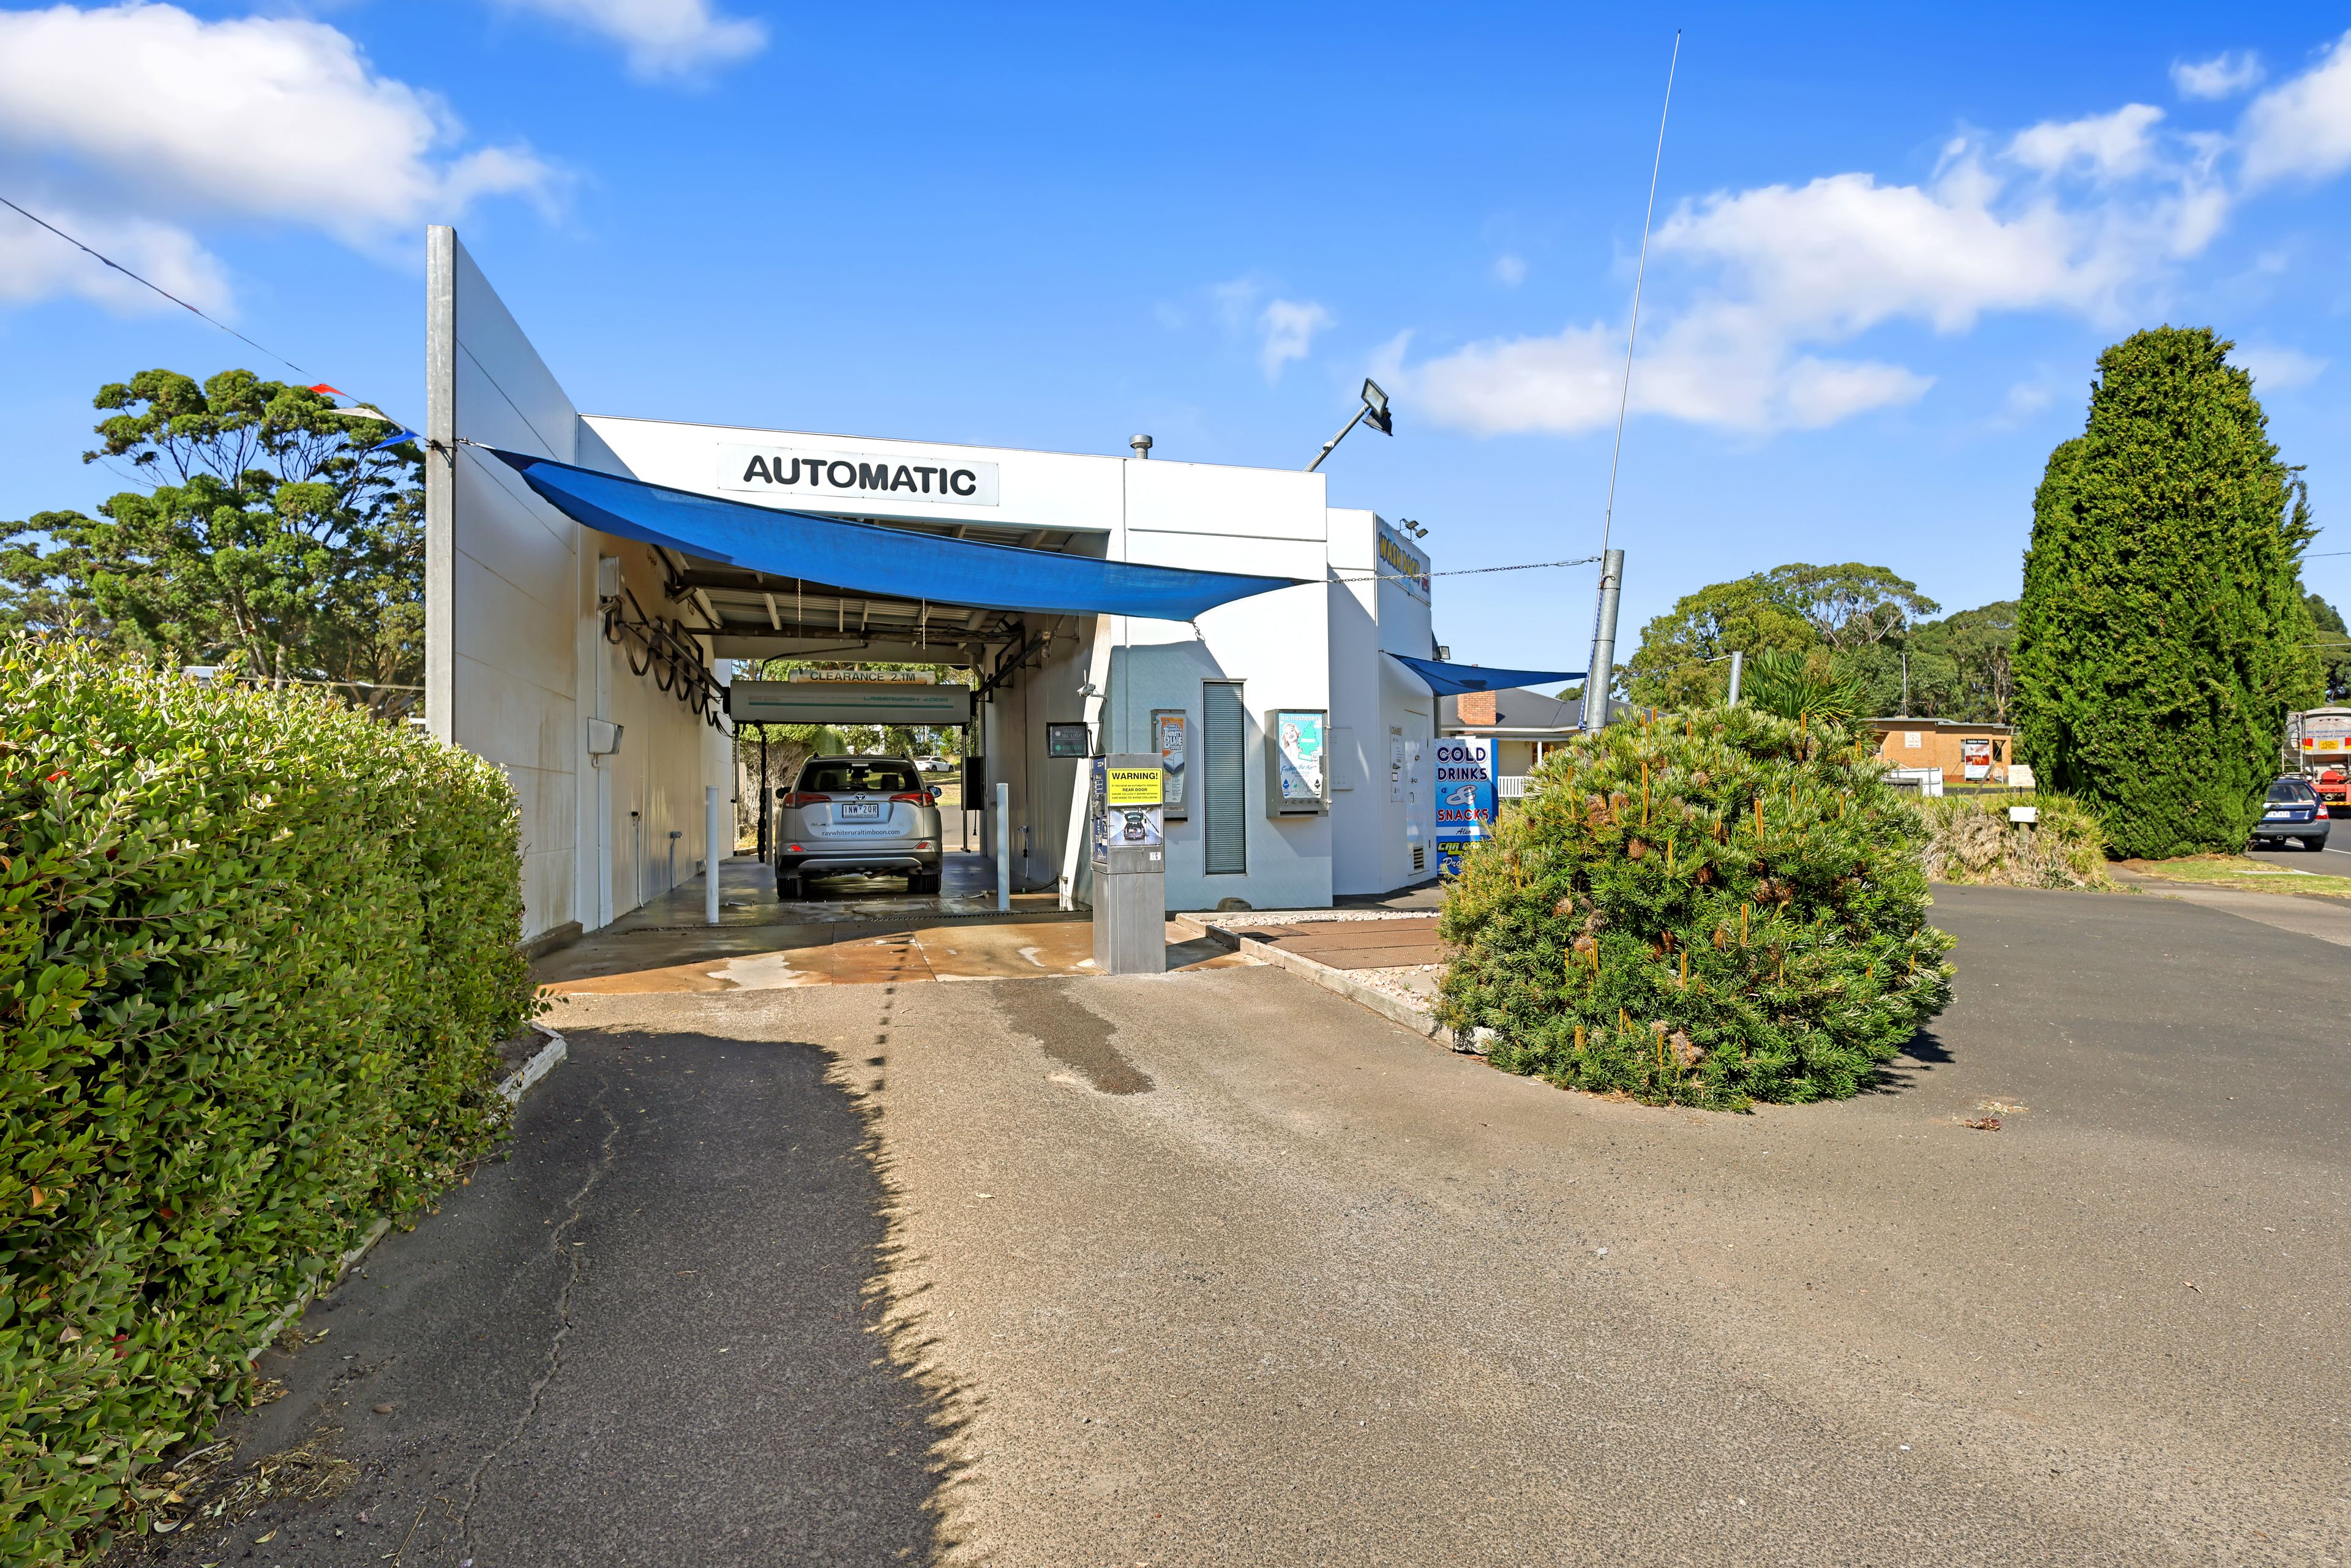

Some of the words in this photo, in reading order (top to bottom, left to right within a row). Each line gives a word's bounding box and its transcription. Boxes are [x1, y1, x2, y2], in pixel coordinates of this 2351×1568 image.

[743, 455, 976, 496] AUTOMATIC
[1379, 535, 1401, 574] WASH
[1402, 550, 1420, 583] DOCK
[811, 671, 885, 681] CLEARANCE
[891, 673, 915, 681] 2.1M
[1163, 727, 1183, 737] THIRSTY
[1164, 736, 1183, 749] BLUE
[1437, 747, 1488, 763] COLD
[1438, 767, 1489, 781] DRINKS
[1445, 784, 1477, 806] &
[1438, 809, 1490, 822] SNACKS
[1438, 842, 1461, 852] CAR
